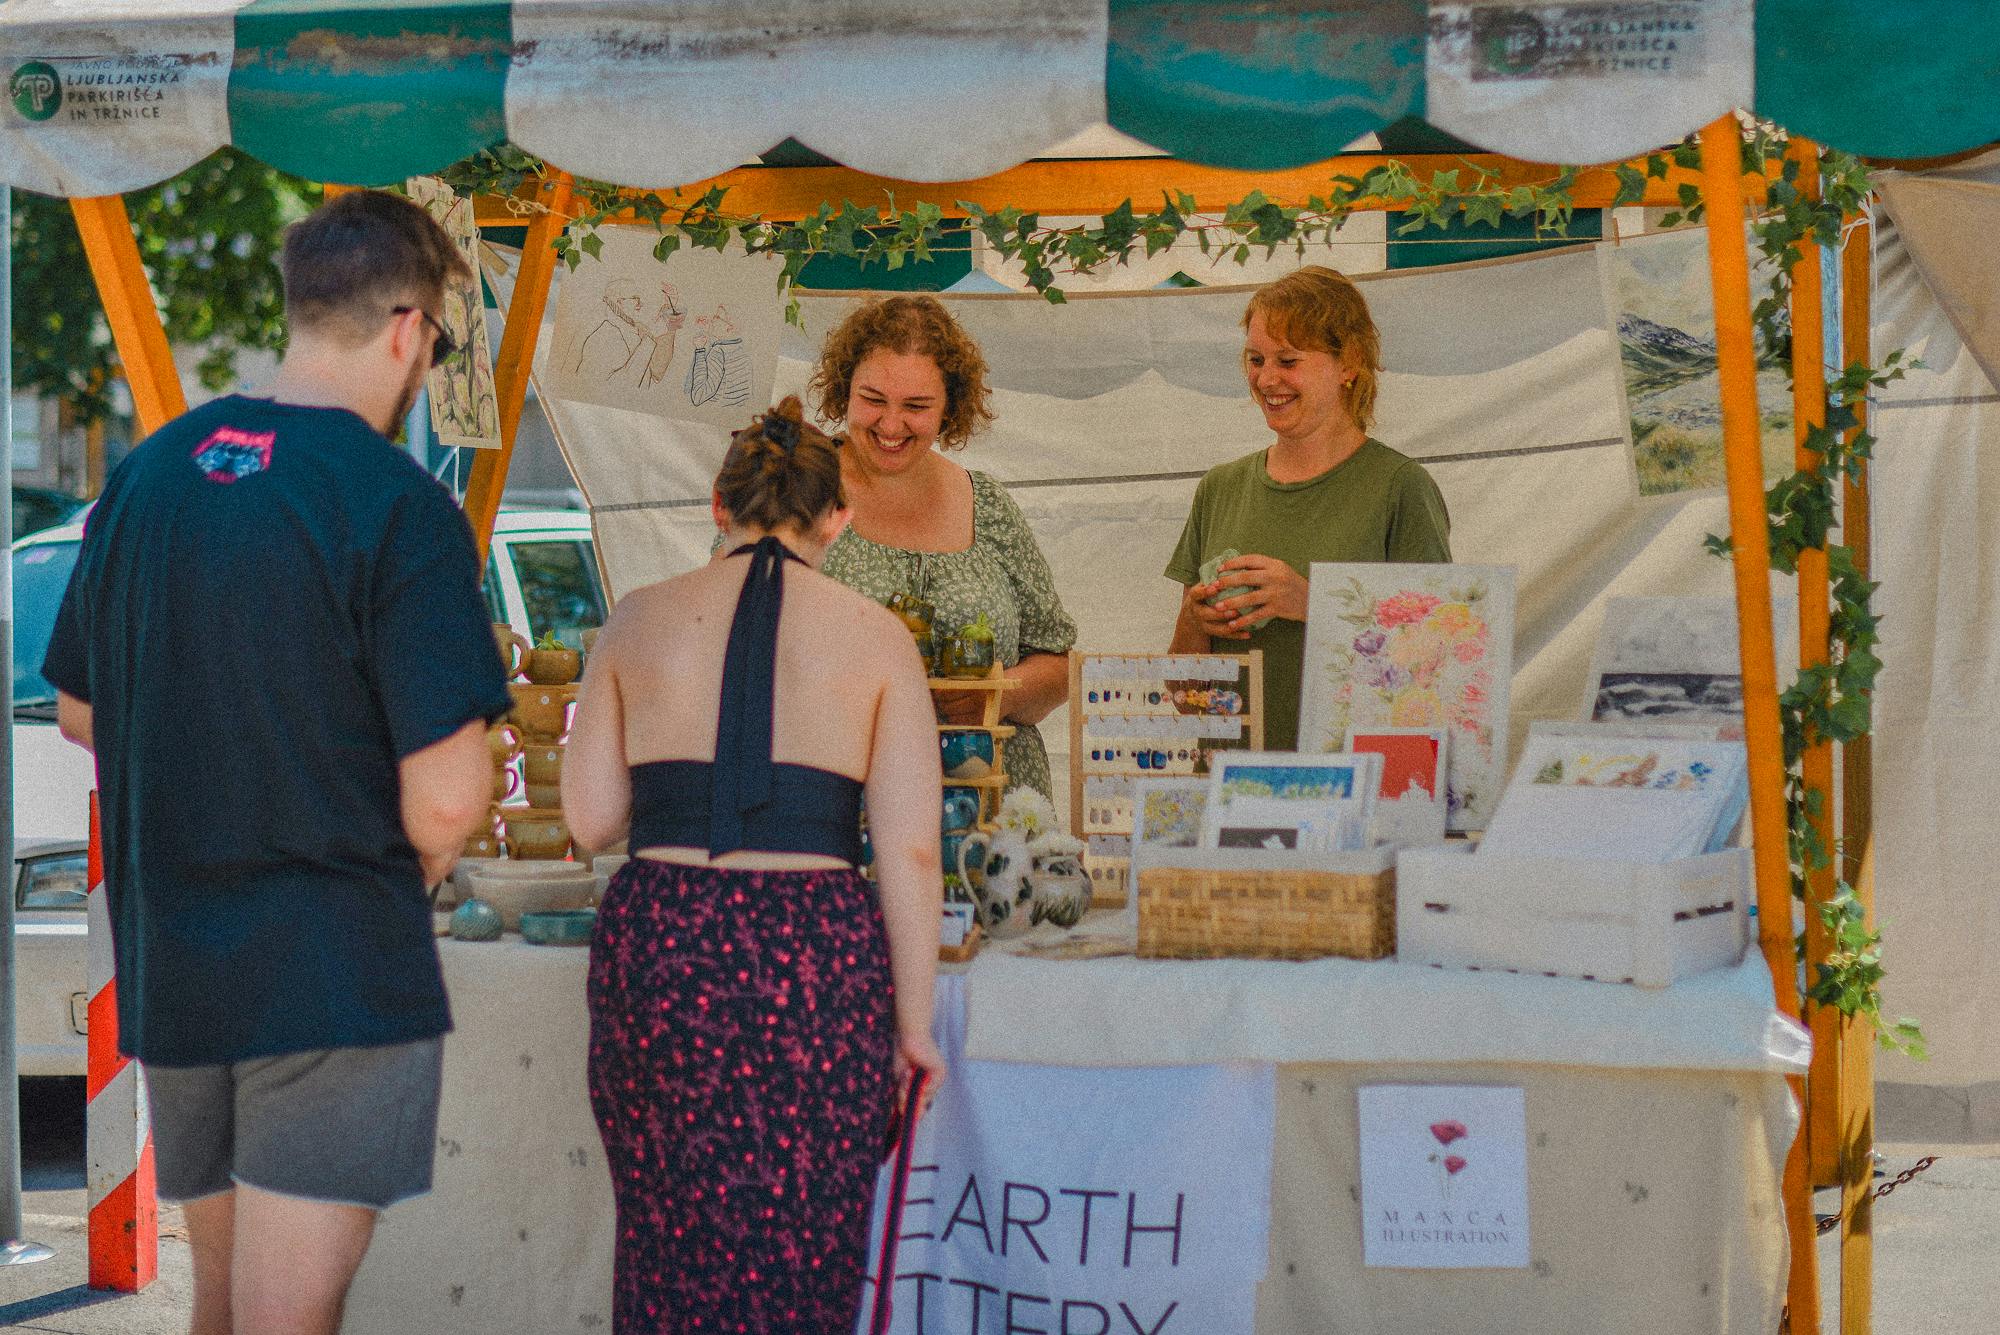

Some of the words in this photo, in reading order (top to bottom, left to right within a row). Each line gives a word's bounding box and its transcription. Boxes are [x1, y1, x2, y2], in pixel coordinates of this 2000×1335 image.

[67, 73, 180, 86] LJUBLJANSKA
[70, 109, 88, 120] IN
[94, 106, 161, 120] TRŽNICE
[897, 1165, 1185, 1268] EARTH
[1384, 1210, 1507, 1226] MANCA
[1382, 1229, 1510, 1245] ILLUSTRATION
[866, 1272, 1179, 1335] TTERY
